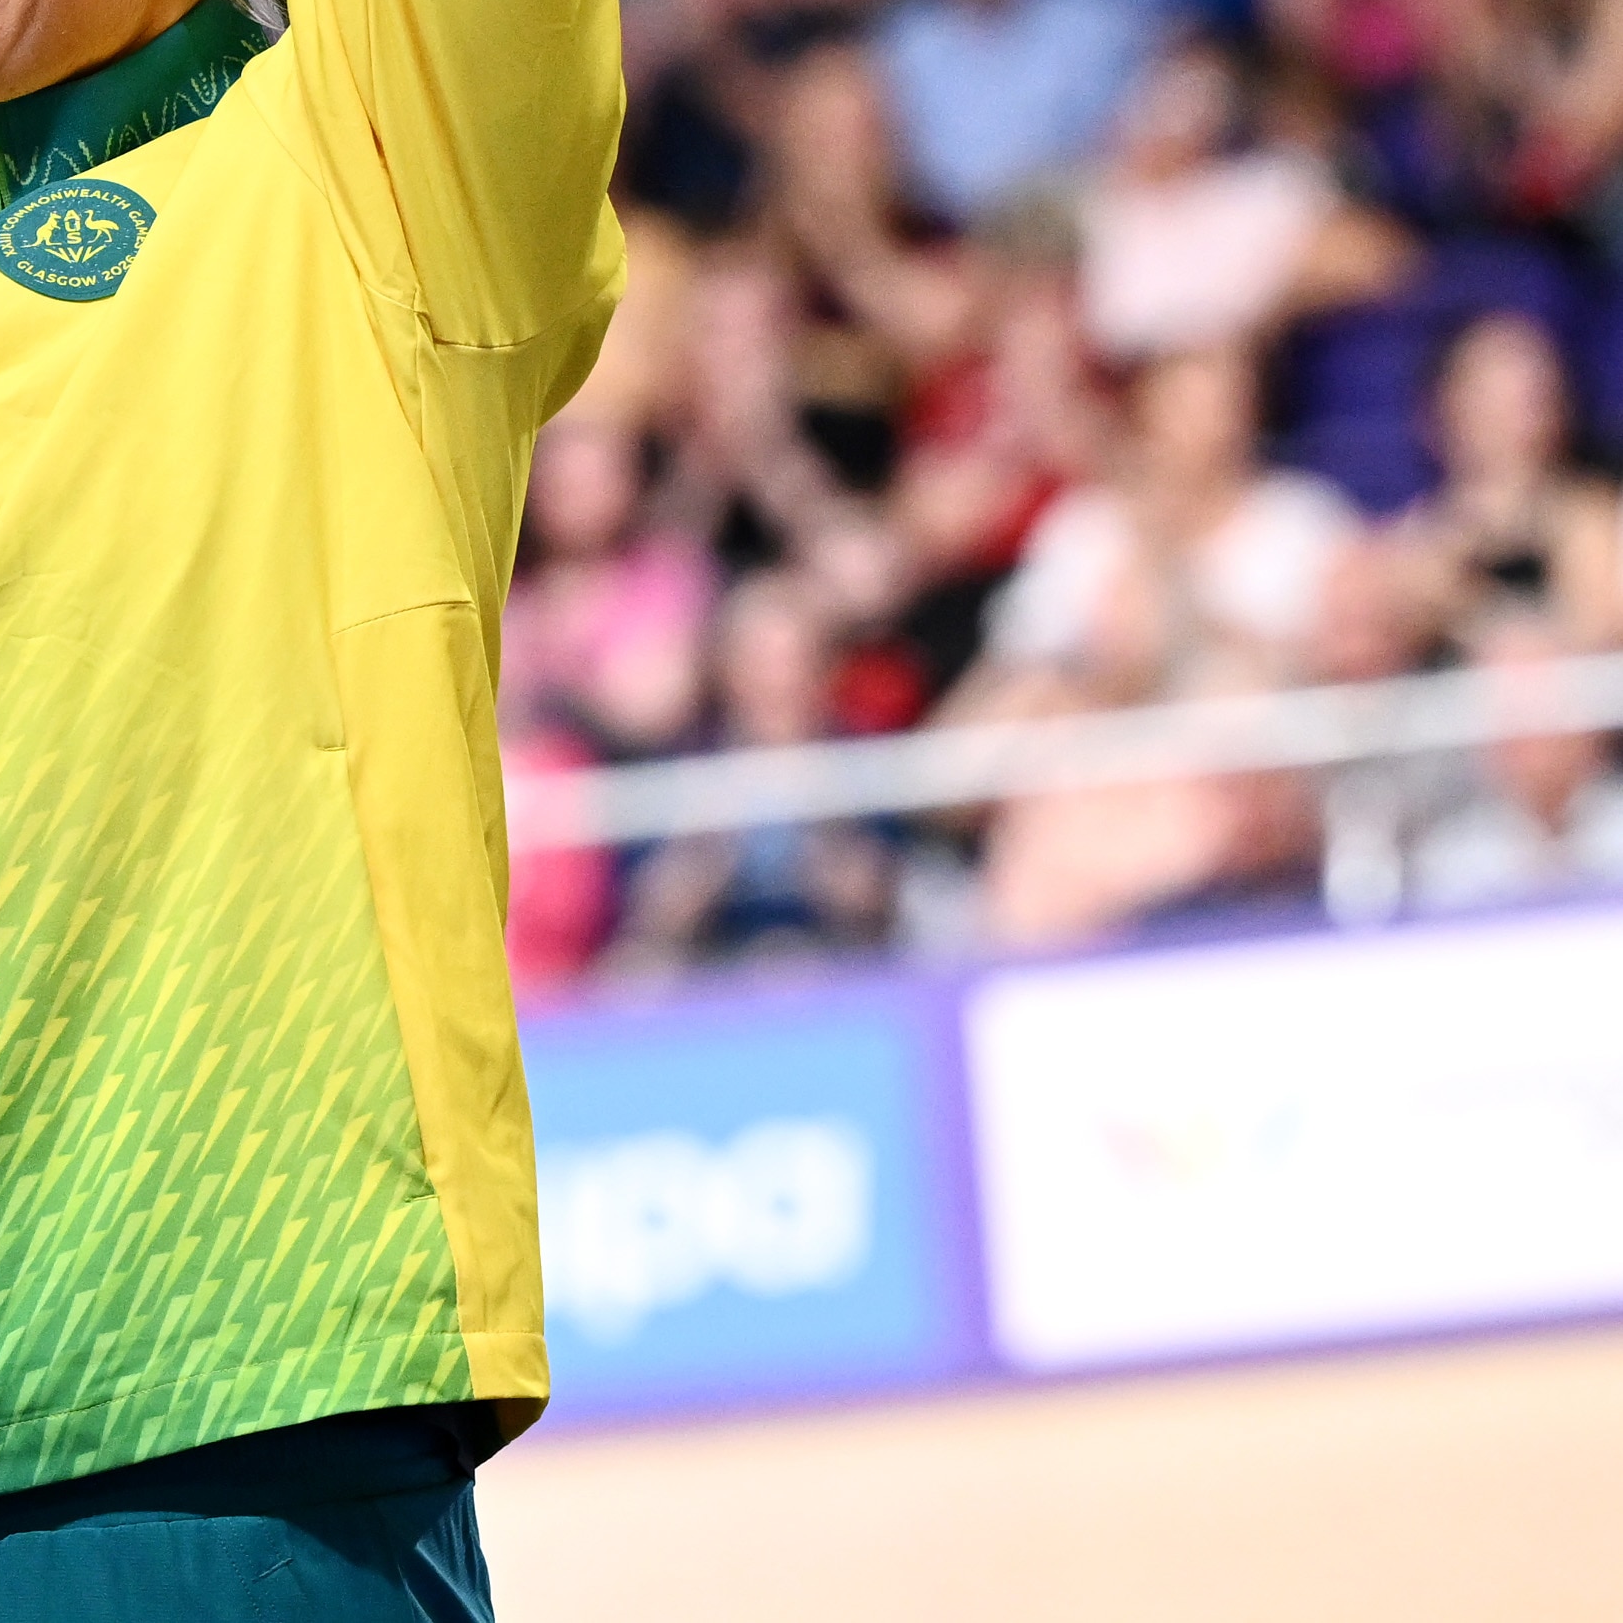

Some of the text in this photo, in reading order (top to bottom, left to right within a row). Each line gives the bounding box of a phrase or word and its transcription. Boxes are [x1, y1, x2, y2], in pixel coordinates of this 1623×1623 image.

[3, 188, 131, 230] COMMONWEALTH
[63, 209, 83, 244] AUS
[17, 255, 136, 288] GLASGOW 2026
